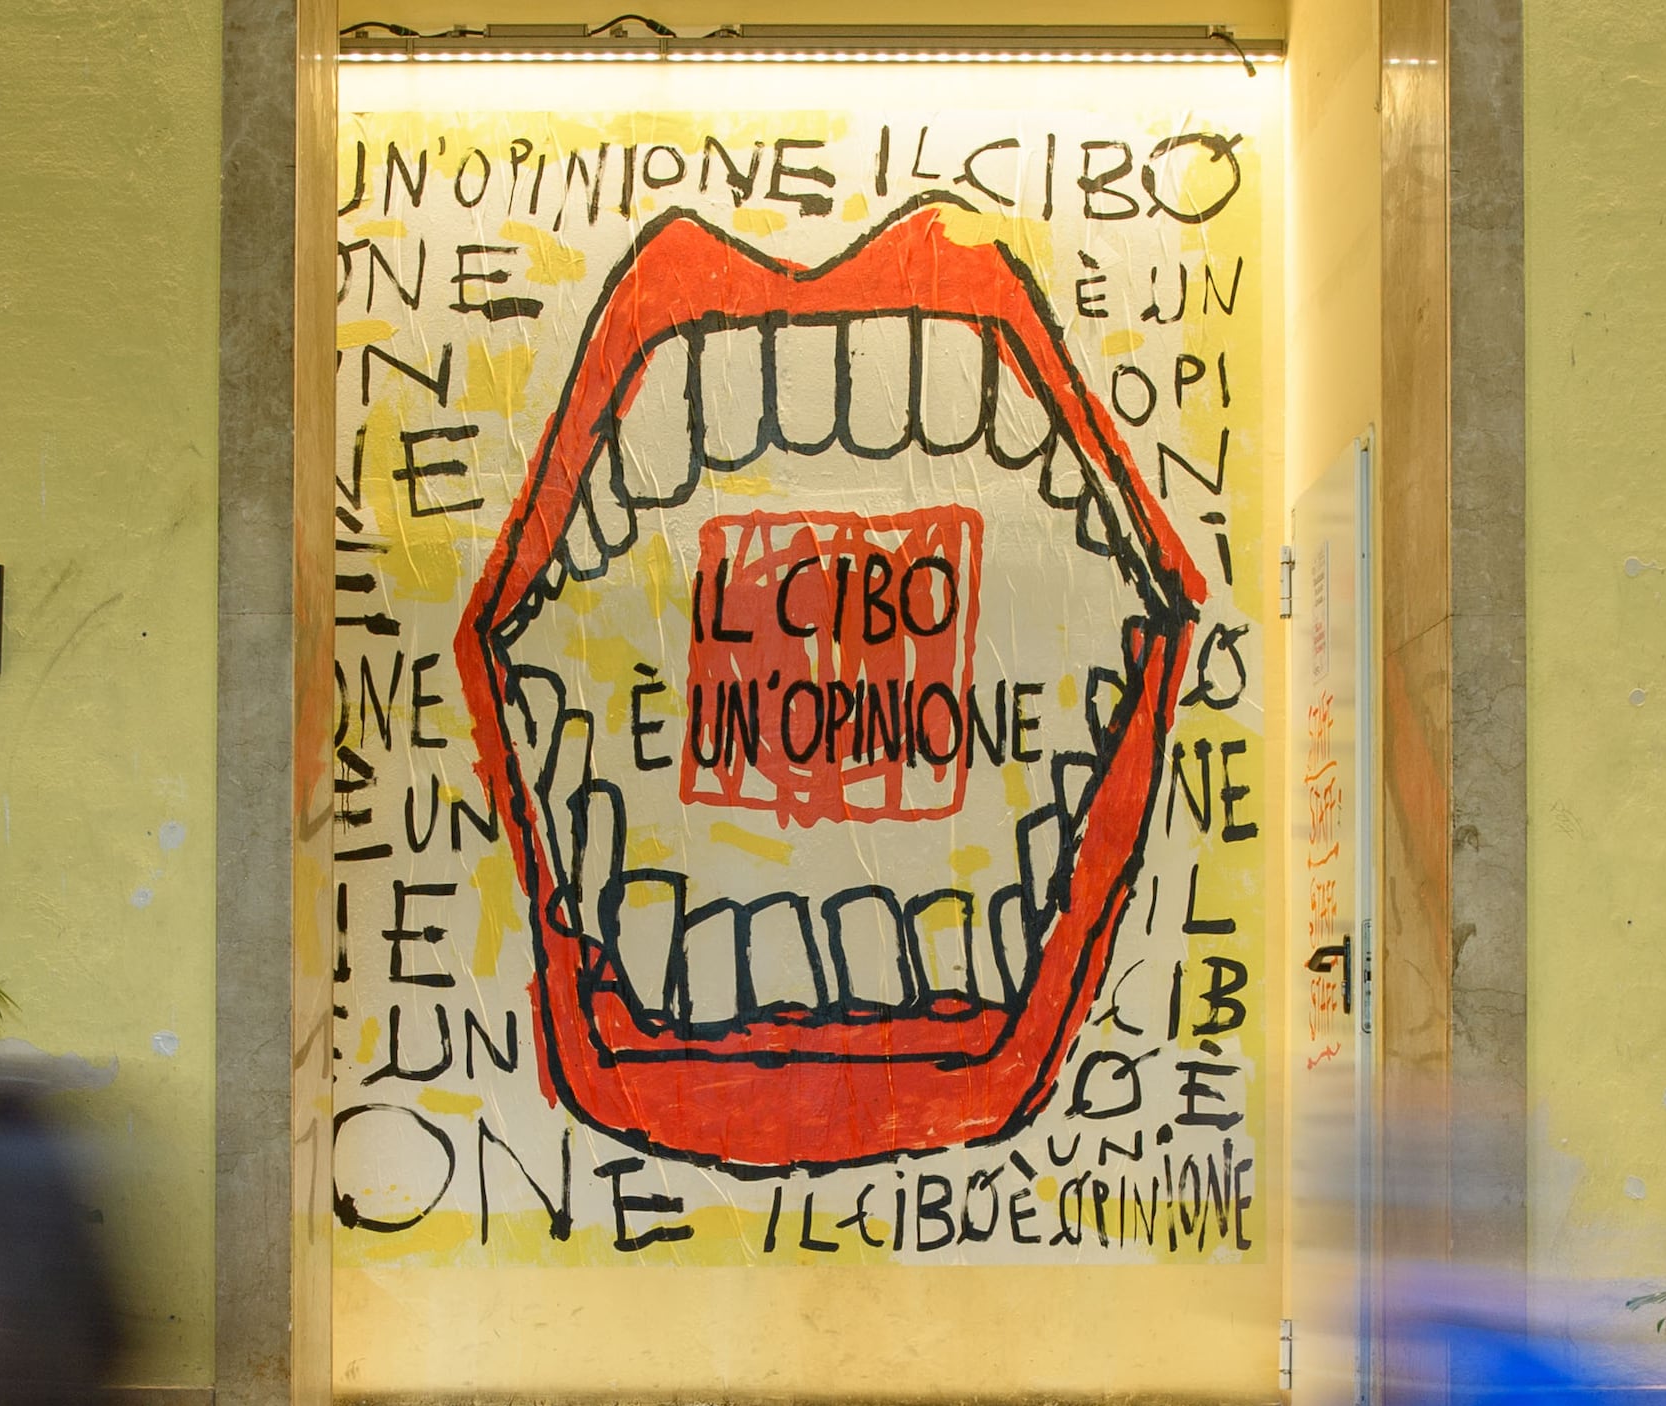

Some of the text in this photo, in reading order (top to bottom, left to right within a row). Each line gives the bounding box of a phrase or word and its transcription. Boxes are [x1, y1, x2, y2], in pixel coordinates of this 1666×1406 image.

[1140, 256, 1244, 324] UN
[693, 552, 961, 645] IL CIBO
[690, 670, 1045, 770] UN'OPINIONE
[333, 1102, 695, 1254] ONE
